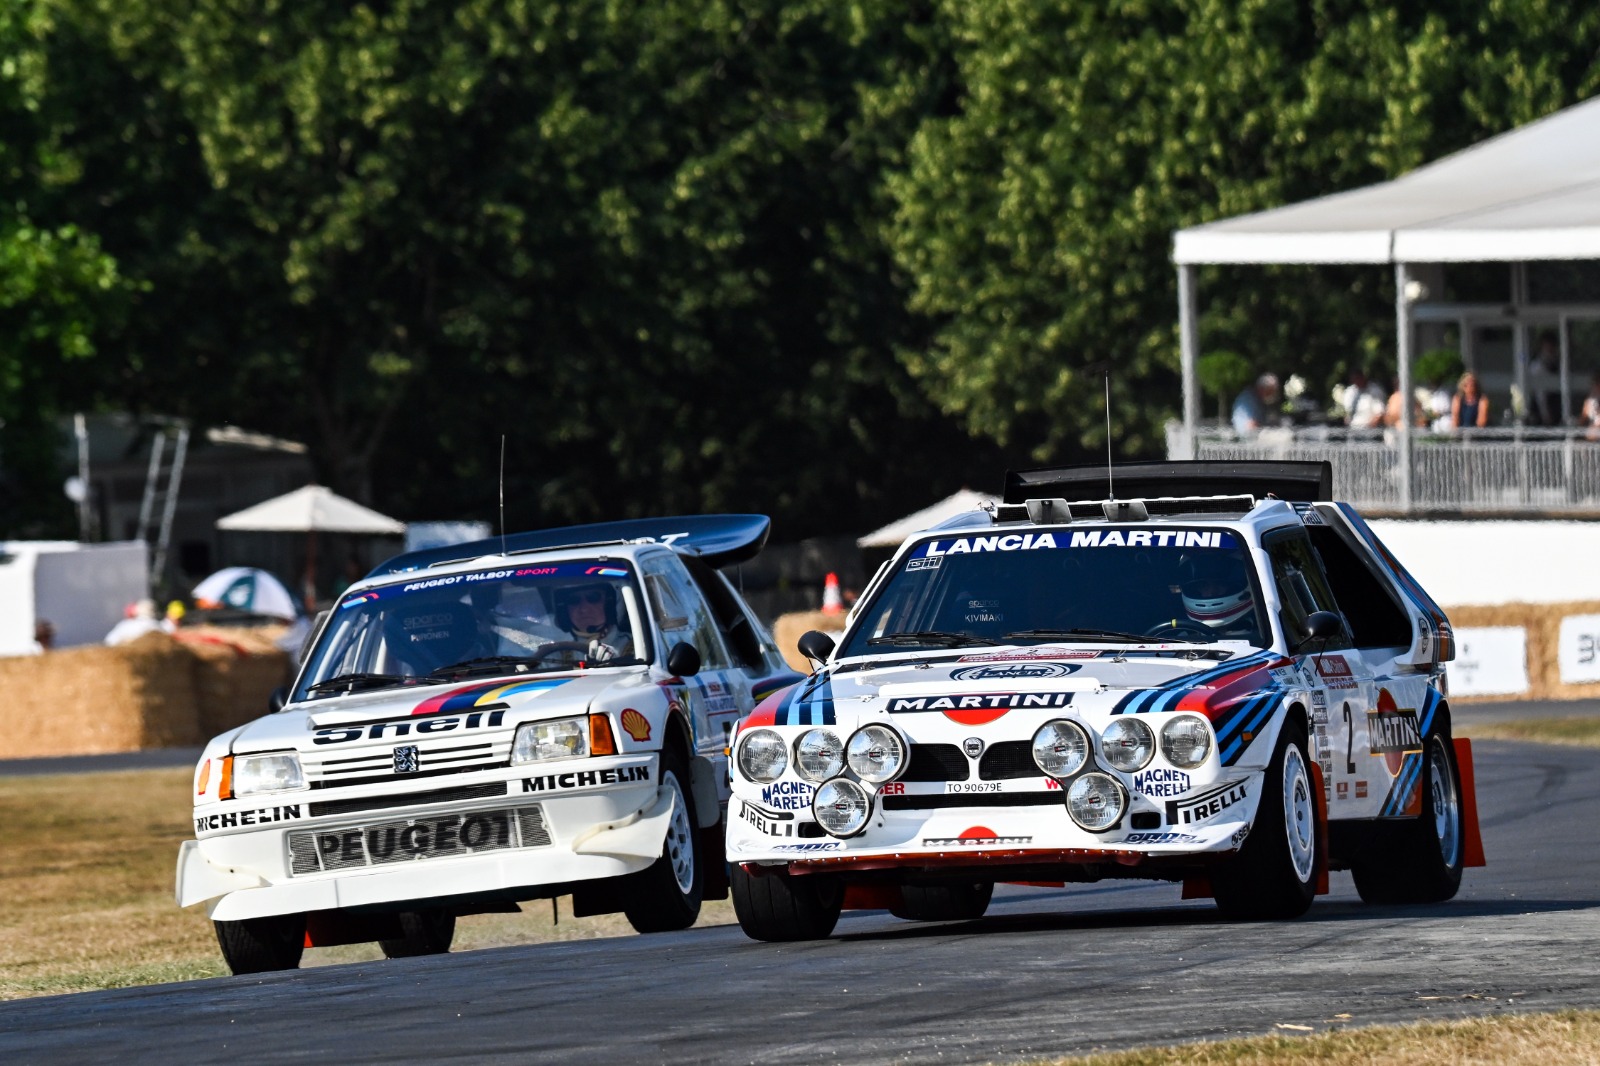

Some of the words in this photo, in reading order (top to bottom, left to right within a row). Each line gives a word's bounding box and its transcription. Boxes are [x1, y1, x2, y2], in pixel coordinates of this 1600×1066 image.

[926, 533, 1057, 557] LANCIA
[1070, 531, 1221, 548] MARTINI
[404, 575, 463, 592] PEUGEOT
[465, 570, 515, 583] TALBOT
[516, 567, 558, 577] SPORT
[893, 692, 1067, 711] MARTINI
[1343, 701, 1355, 774] 2
[1369, 715, 1421, 748] MARTINI
[521, 766, 650, 793] MICHELIN
[947, 783, 962, 793] TO
[964, 782, 1002, 792] 90679E
[1134, 768, 1190, 785] MAGNETI
[1134, 782, 1190, 797] MARELLI
[1165, 776, 1250, 825] PIRELLI
[197, 804, 300, 832] MICHELIN
[320, 816, 512, 862] PEUGEOT
[925, 837, 1032, 847] MARTINI
